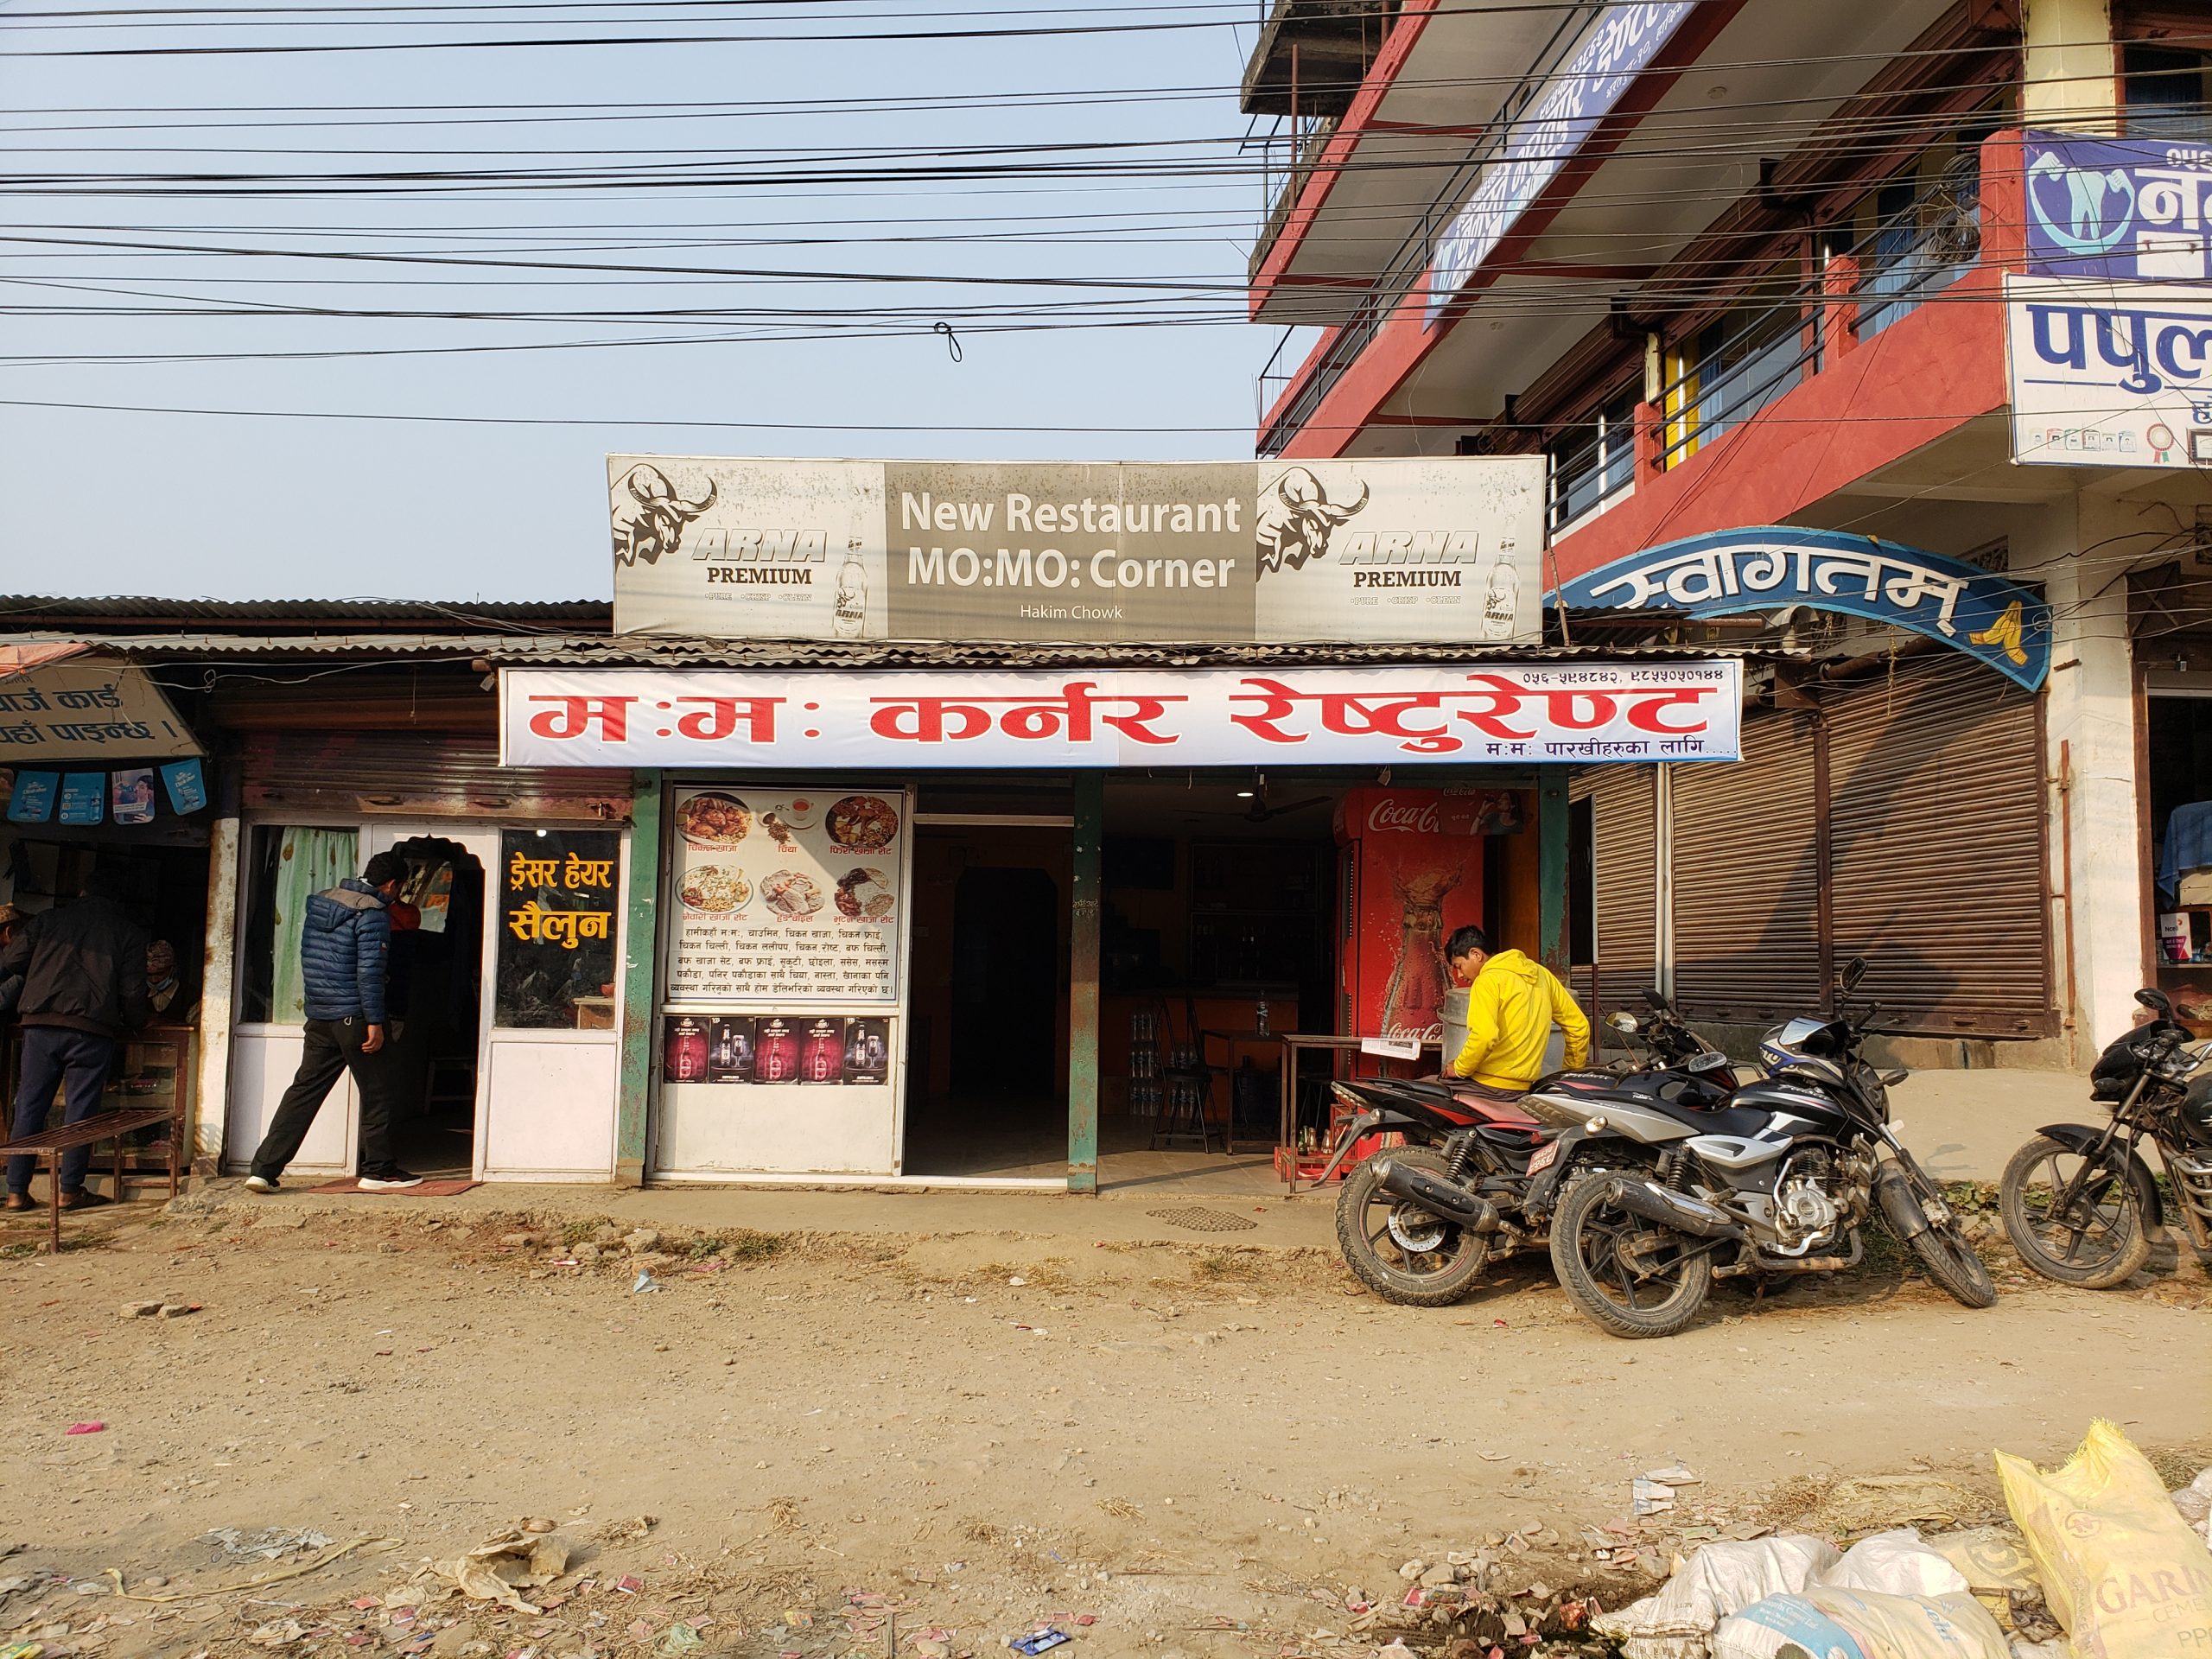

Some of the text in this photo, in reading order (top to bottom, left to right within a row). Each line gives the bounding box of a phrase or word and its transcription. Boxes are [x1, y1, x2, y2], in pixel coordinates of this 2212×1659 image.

[901, 492, 1241, 533] New Restaurant
[692, 528, 827, 563] ARNA
[1338, 531, 1479, 566] ARNA
[707, 567, 812, 584] PREMIUM
[907, 546, 1235, 588] MO:MO: Corner
[1353, 570, 1462, 588] PREMIUM
[1590, 544, 1969, 638] स्वागतम्
[835, 609, 863, 620] ARNA
[1020, 604, 1123, 620] Hakim Chowk
[1484, 611, 1513, 621] ARNA
[52, 683, 123, 709] कार्ड
[868, 681, 1189, 746] कर्नर
[1229, 674, 1718, 754] रेष्टुरेण्ट
[1544, 737, 1651, 759] पारखीहरुका
[511, 851, 613, 891] ड्रेसर हेयर
[509, 900, 612, 949] सैलुन
[785, 927, 808, 938] चिकन
[838, 928, 861, 939] चिकन
[679, 939, 702, 950] चिकन
[735, 940, 758, 950] चिकन
[796, 941, 817, 951] चिकन
[874, 969, 889, 980] पनि
